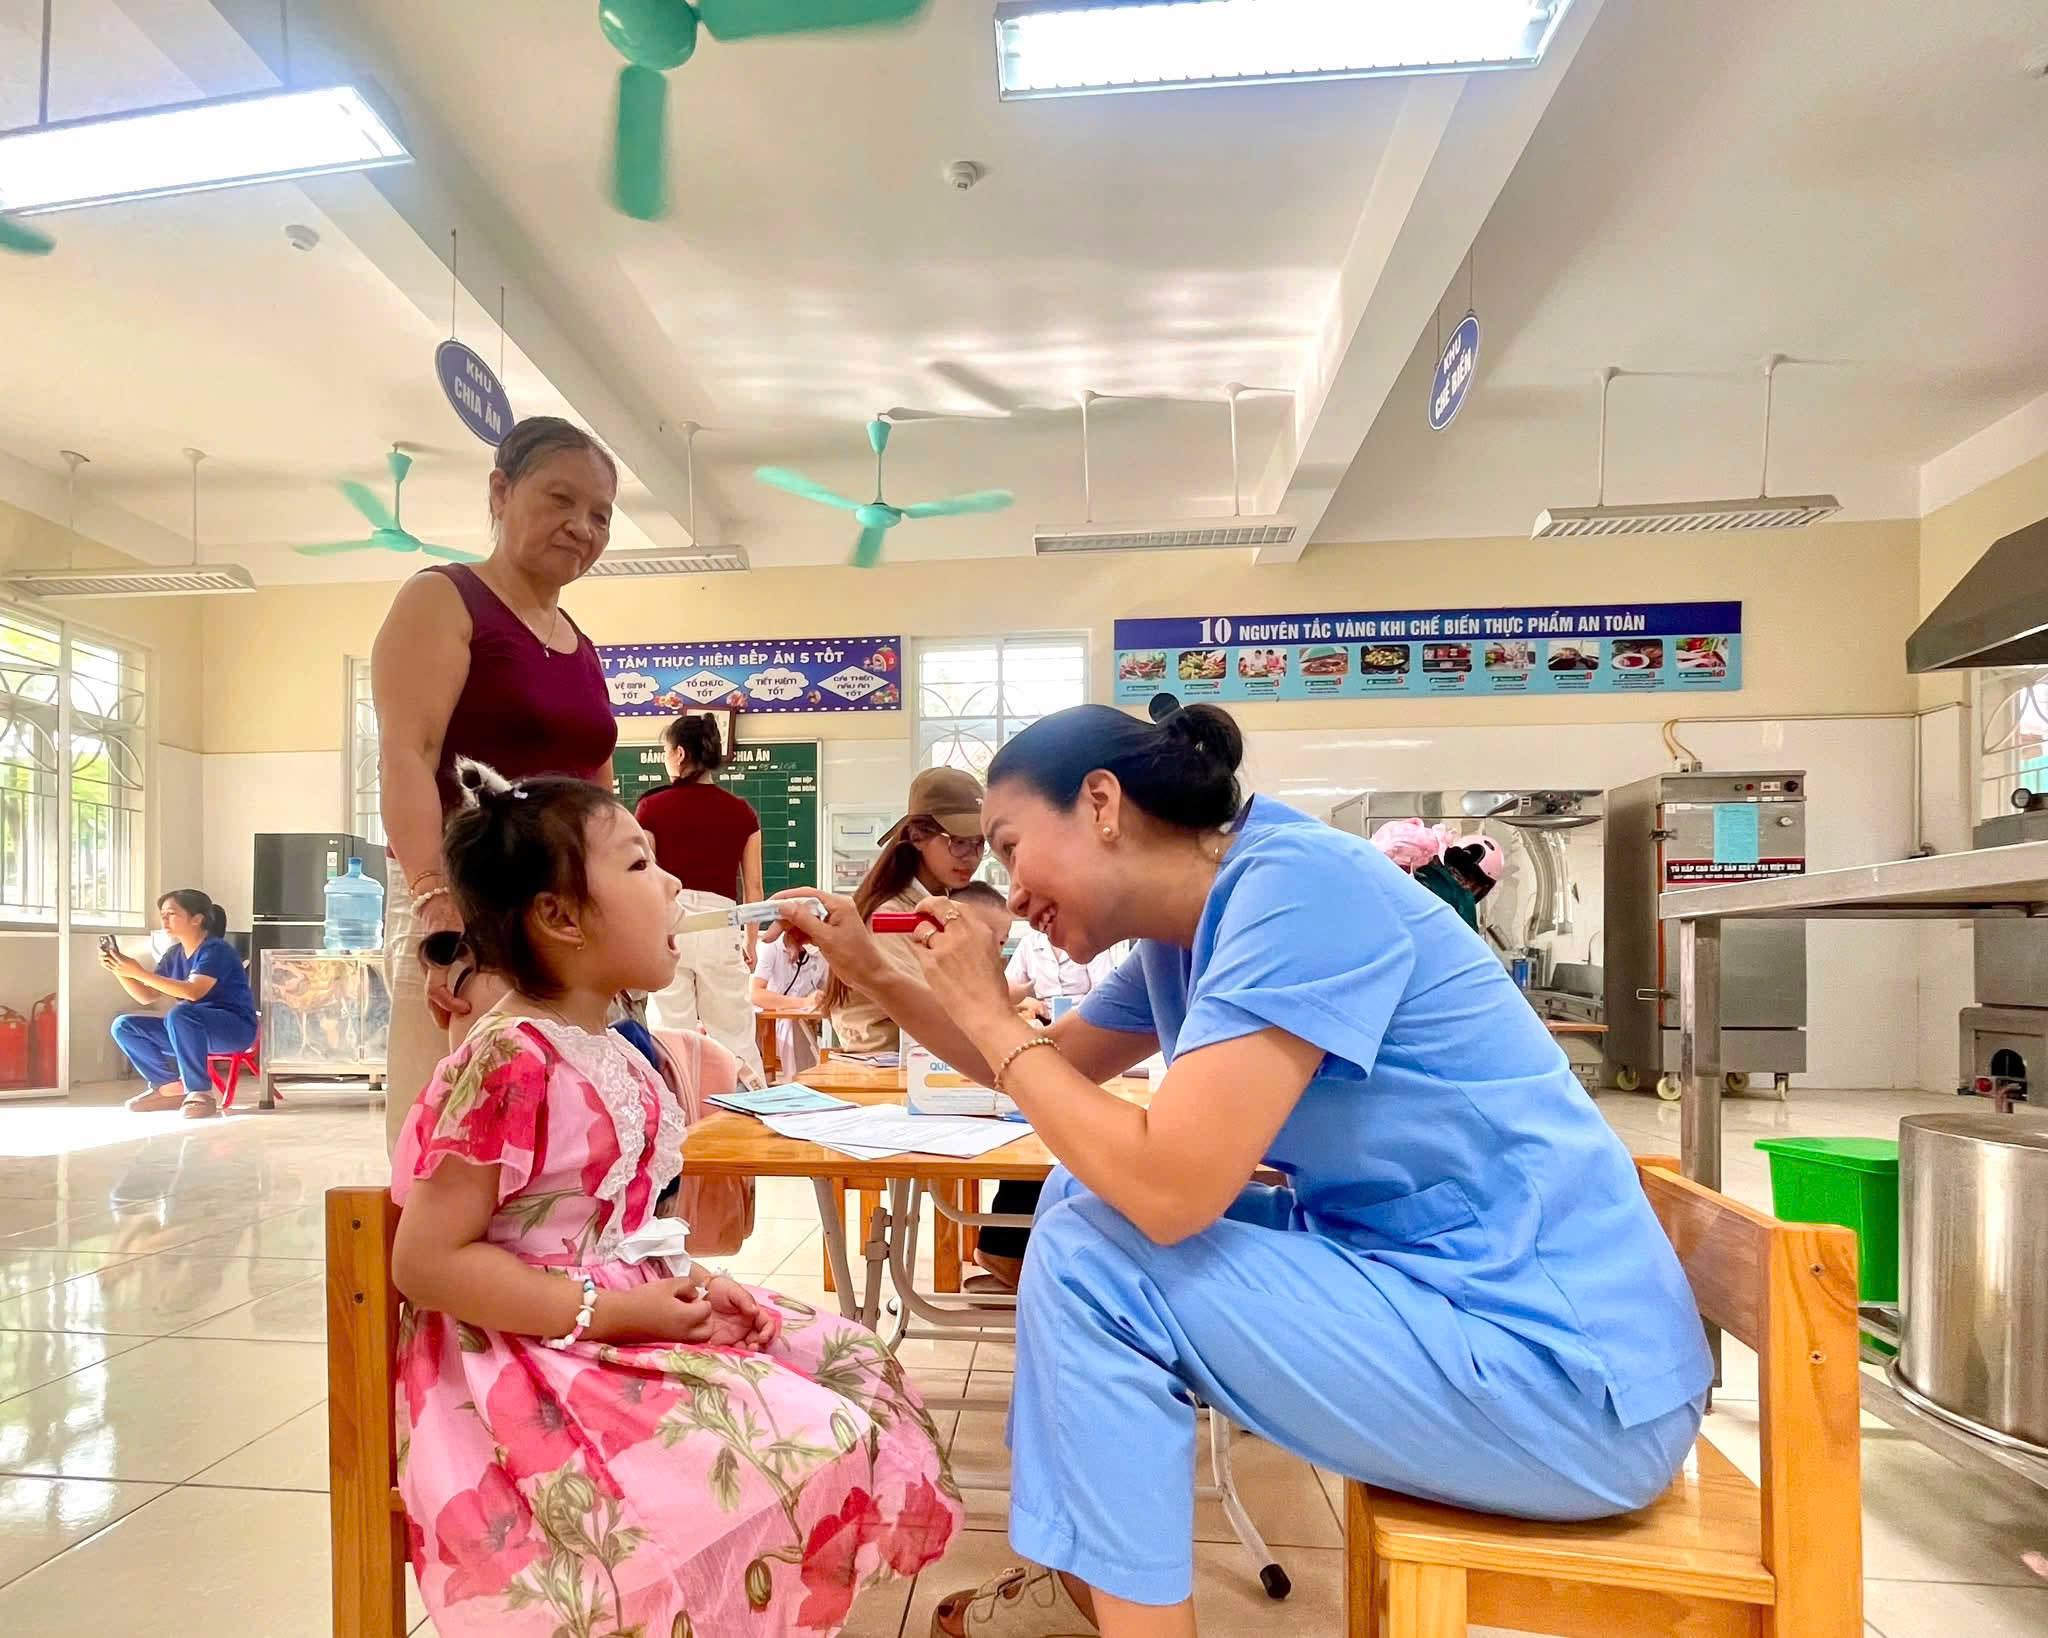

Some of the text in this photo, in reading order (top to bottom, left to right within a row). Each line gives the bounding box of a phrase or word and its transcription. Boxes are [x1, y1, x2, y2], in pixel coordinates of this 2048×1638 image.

[466, 358, 492, 393] KHU
[454, 376, 501, 434] CHIA ĂN
[1200, 611, 1644, 644] 10 NGUYÊN TẮC VÀNG KHI CHẾ BIẾN THỰC PHẨM AN TOÀN
[617, 654, 648, 668] TÂM
[653, 656, 694, 671] THỰC
[700, 652, 734, 668] HIỆN
[740, 648, 768, 665] BẾP
[774, 650, 794, 664] ĂN
[800, 652, 810, 663] 5
[815, 646, 844, 662] TỐT
[756, 748, 770, 761] ĂN
